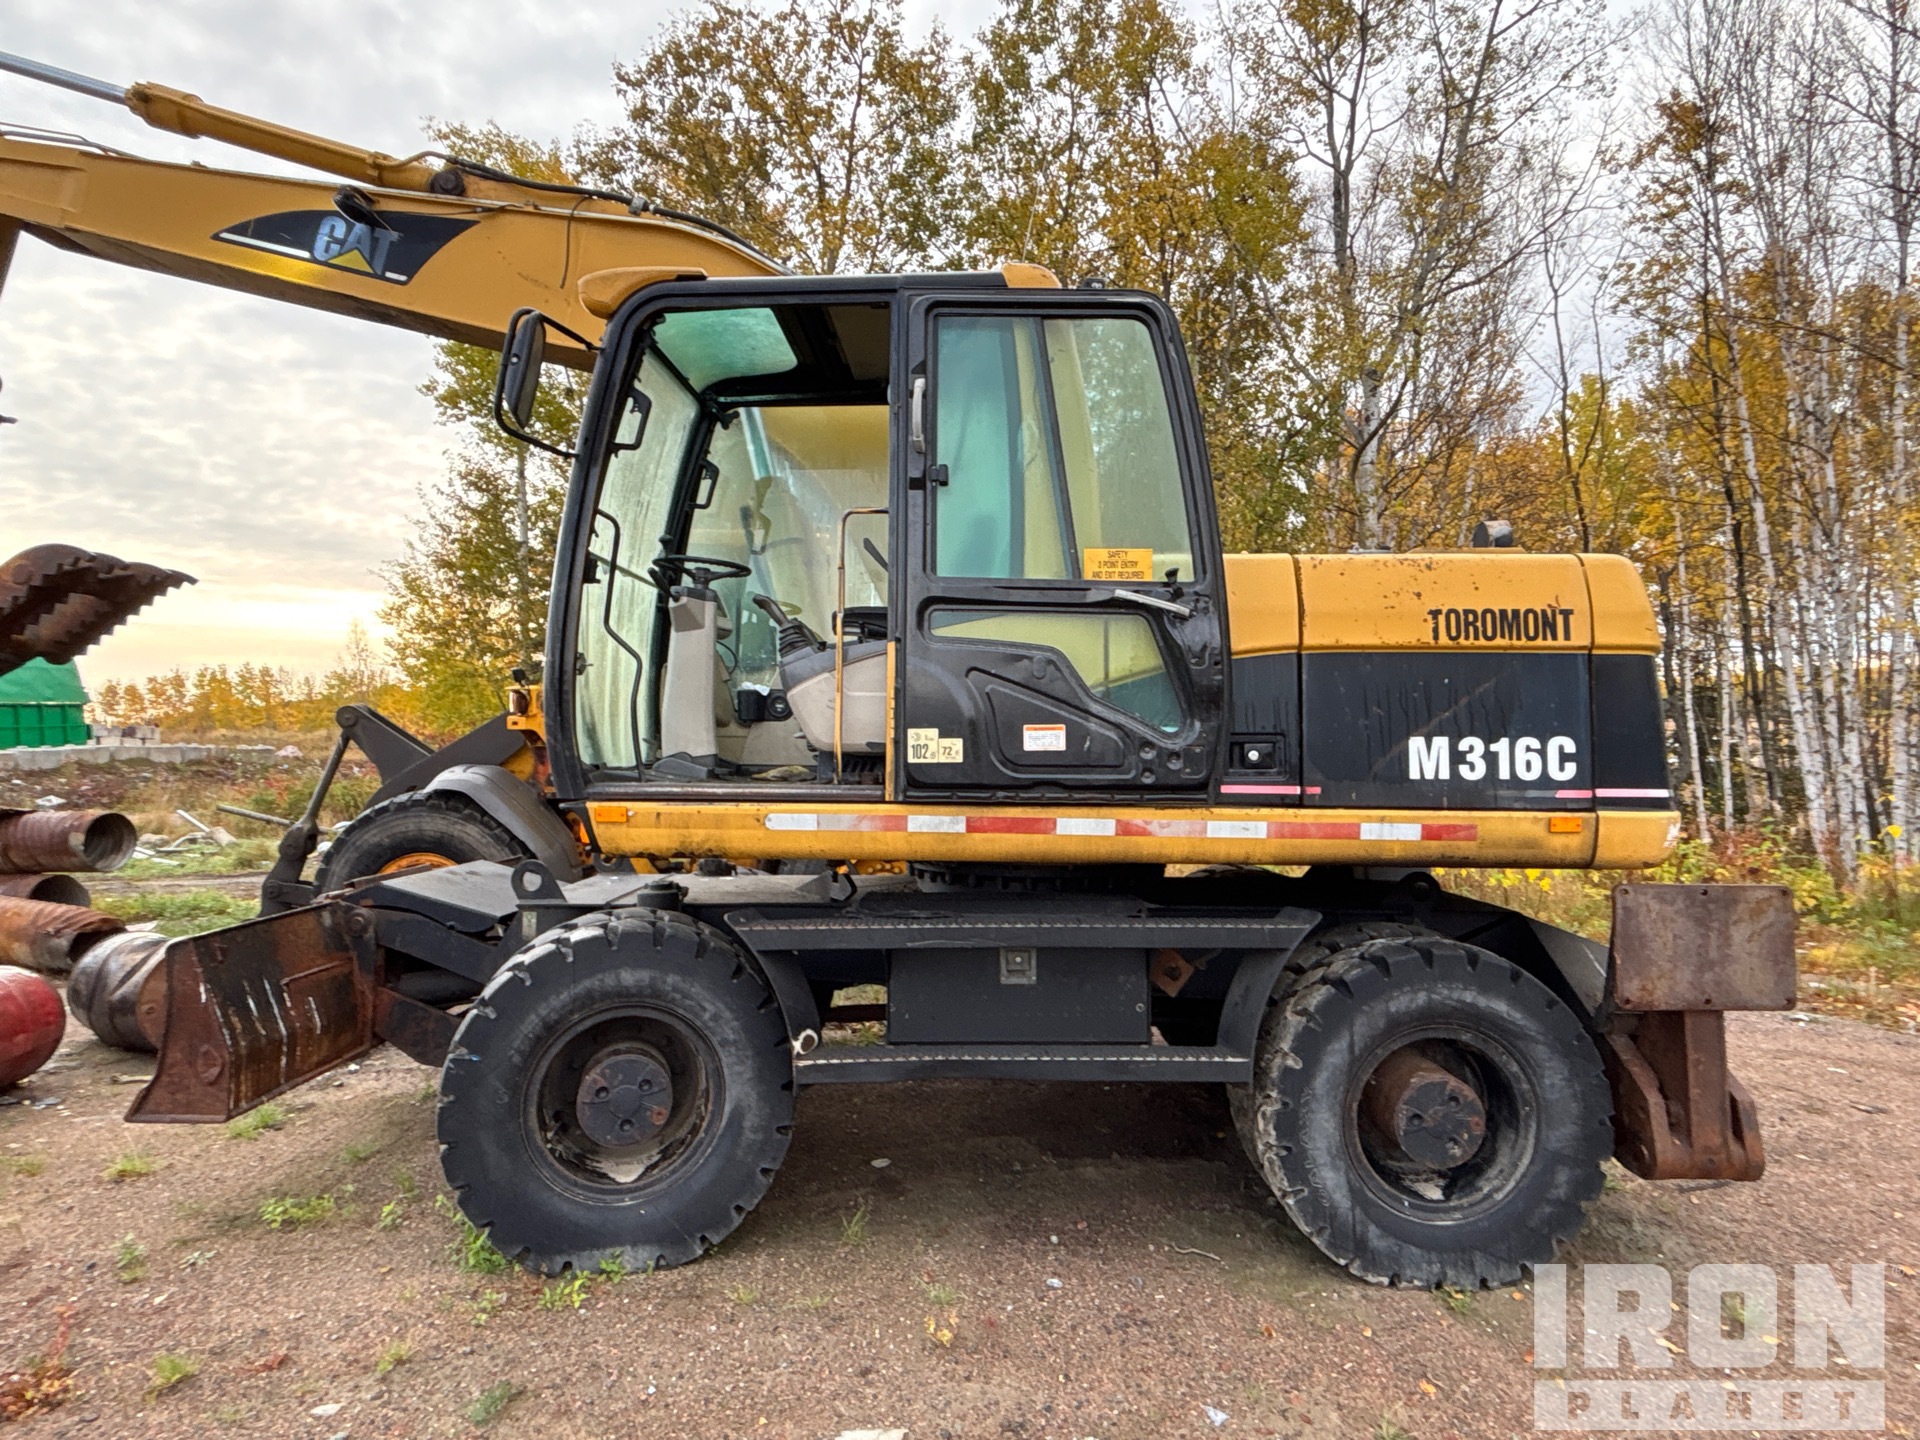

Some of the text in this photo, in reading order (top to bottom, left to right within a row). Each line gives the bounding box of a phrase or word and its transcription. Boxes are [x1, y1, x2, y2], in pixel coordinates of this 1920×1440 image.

[313, 216, 404, 275] CAT
[1107, 550, 1128, 559] SAFETY
[1103, 561, 1119, 569] POINT
[1120, 561, 1139, 569] ENTRY
[1092, 571, 1145, 579] AND EXIT REQUIRED
[1427, 608, 1575, 642] TOROMONT
[910, 743, 929, 760] 102
[941, 746, 953, 756] 72
